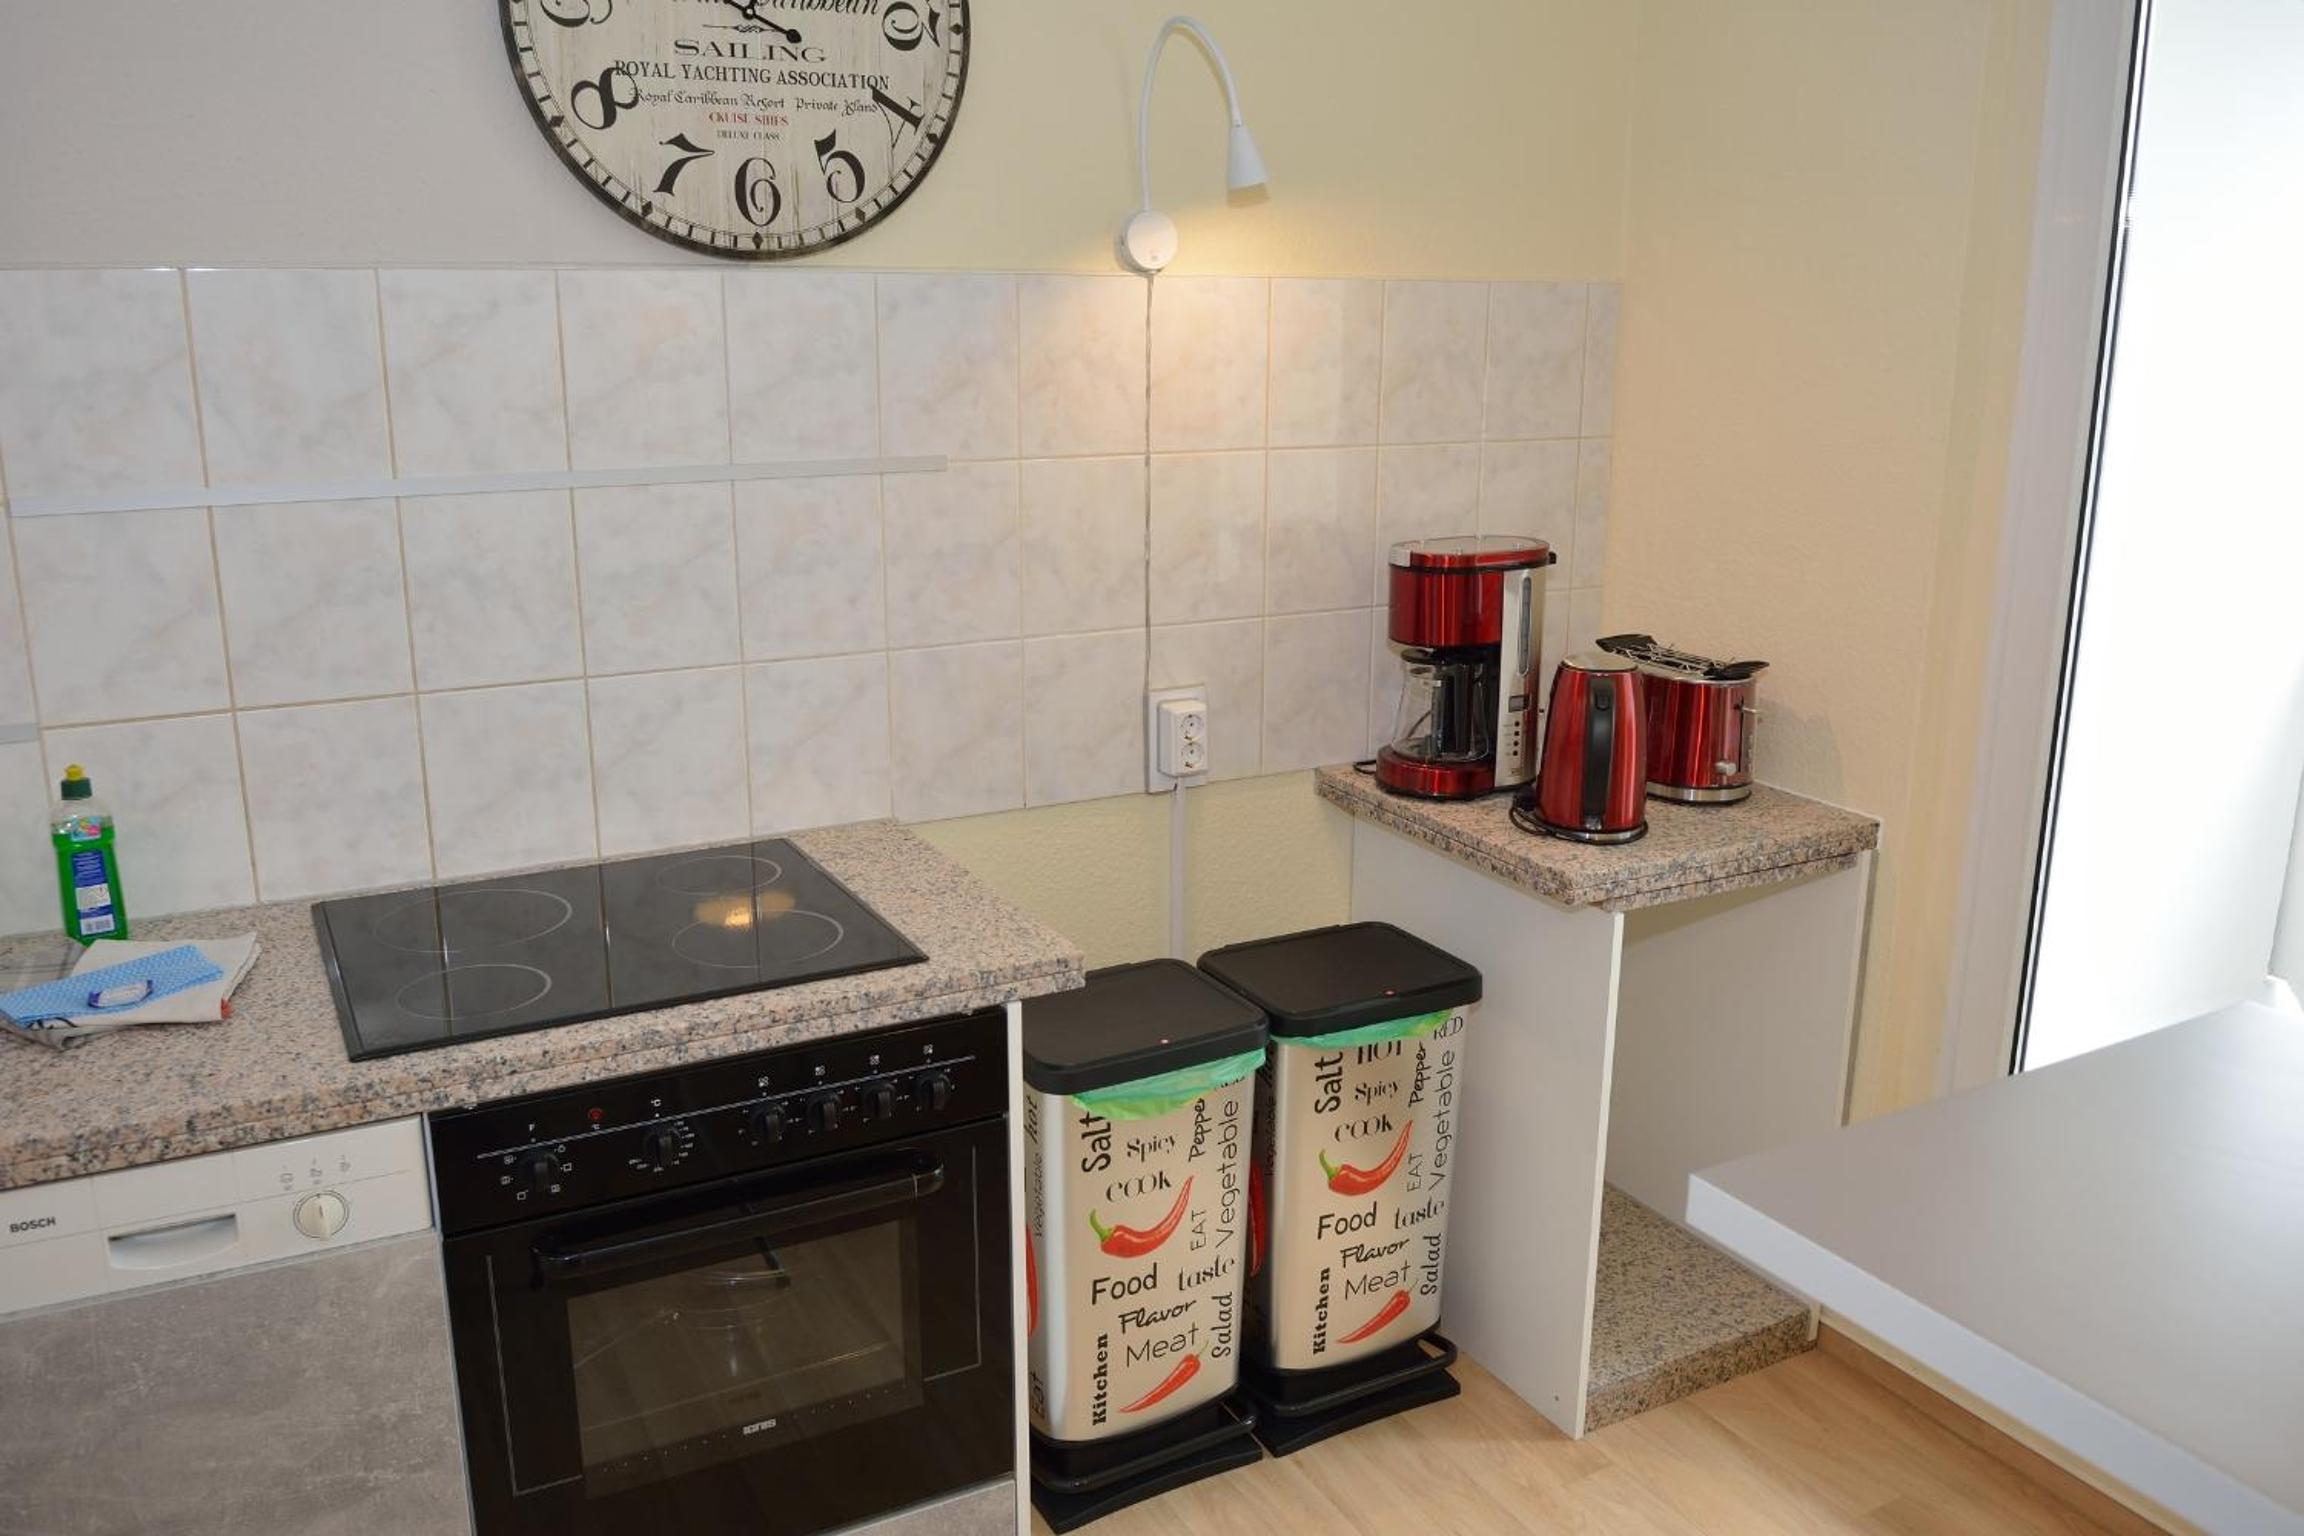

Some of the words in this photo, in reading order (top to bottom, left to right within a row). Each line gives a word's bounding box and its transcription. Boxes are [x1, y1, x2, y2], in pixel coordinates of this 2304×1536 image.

[615, 60, 675, 79] ROYAL
[681, 65, 771, 84] YACHTING
[776, 70, 890, 90] ASSOCIATION
[674, 39, 826, 63] SAILING
[571, 67, 639, 130] 8
[674, 89, 738, 106] Caribbean
[652, 133, 715, 197] 7
[735, 157, 782, 227] 6
[815, 130, 865, 203] 5
[1314, 1051, 1343, 1114] Salt
[1354, 1079, 1400, 1106] Spicy
[1408, 1041, 1430, 1107] Pepper
[1079, 1111, 1111, 1173] Salt
[1188, 1097, 1212, 1163] Peppe
[1429, 1049, 1455, 1190] Vegetable
[1127, 1135, 1176, 1163] Spicy
[1215, 1100, 1241, 1249] Vegetable
[1406, 1153, 1423, 1192] EAT
[9, 1216, 56, 1233] BOSCH
[1190, 1208, 1208, 1252] EAT
[1317, 1202, 1377, 1240] Food
[1340, 1237, 1410, 1268] Flavor
[1345, 1260, 1411, 1299] Meat
[1421, 1232, 1442, 1295] Salad
[1091, 1262, 1158, 1305] Food
[1313, 1267, 1331, 1354] Kitchen
[1118, 1299, 1198, 1335] Flavor
[1211, 1291, 1233, 1358] Salad
[1125, 1322, 1200, 1368] Meat
[1092, 1332, 1109, 1425] Kitchen
